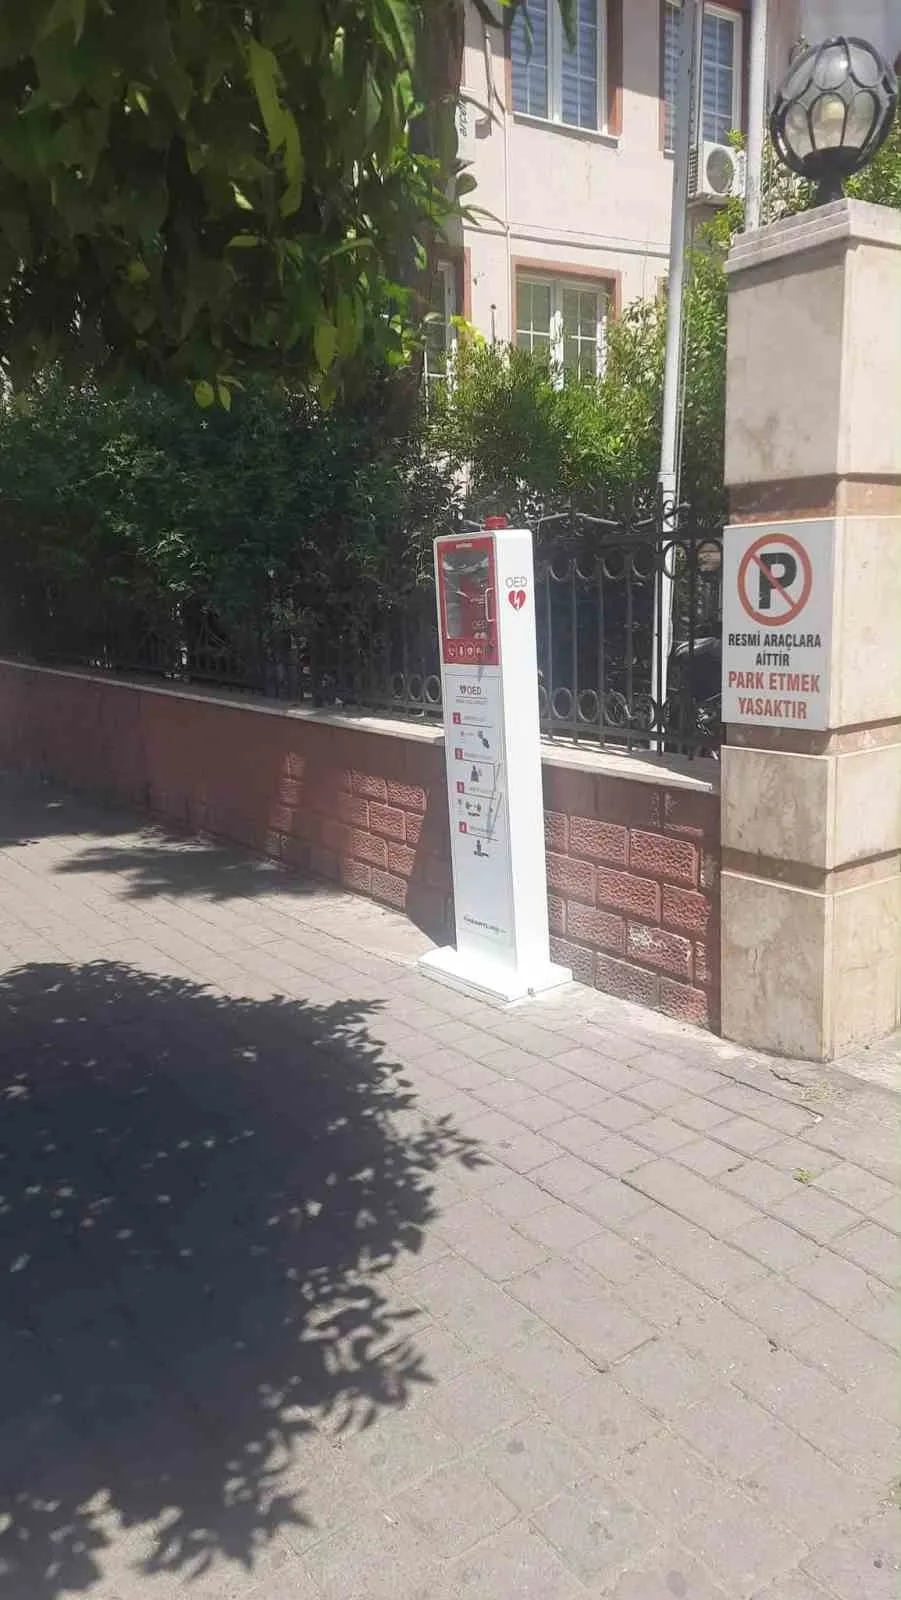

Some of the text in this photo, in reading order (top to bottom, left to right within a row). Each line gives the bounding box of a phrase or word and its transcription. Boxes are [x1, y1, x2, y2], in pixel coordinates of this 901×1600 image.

[505, 576, 528, 588] OED
[728, 631, 822, 651] RESMİ ARAÇLARA
[755, 650, 790, 667] AİTTİR
[467, 686, 482, 696] OED
[728, 671, 820, 693] PARK ETMEK
[737, 697, 807, 719] YASAKTIR
